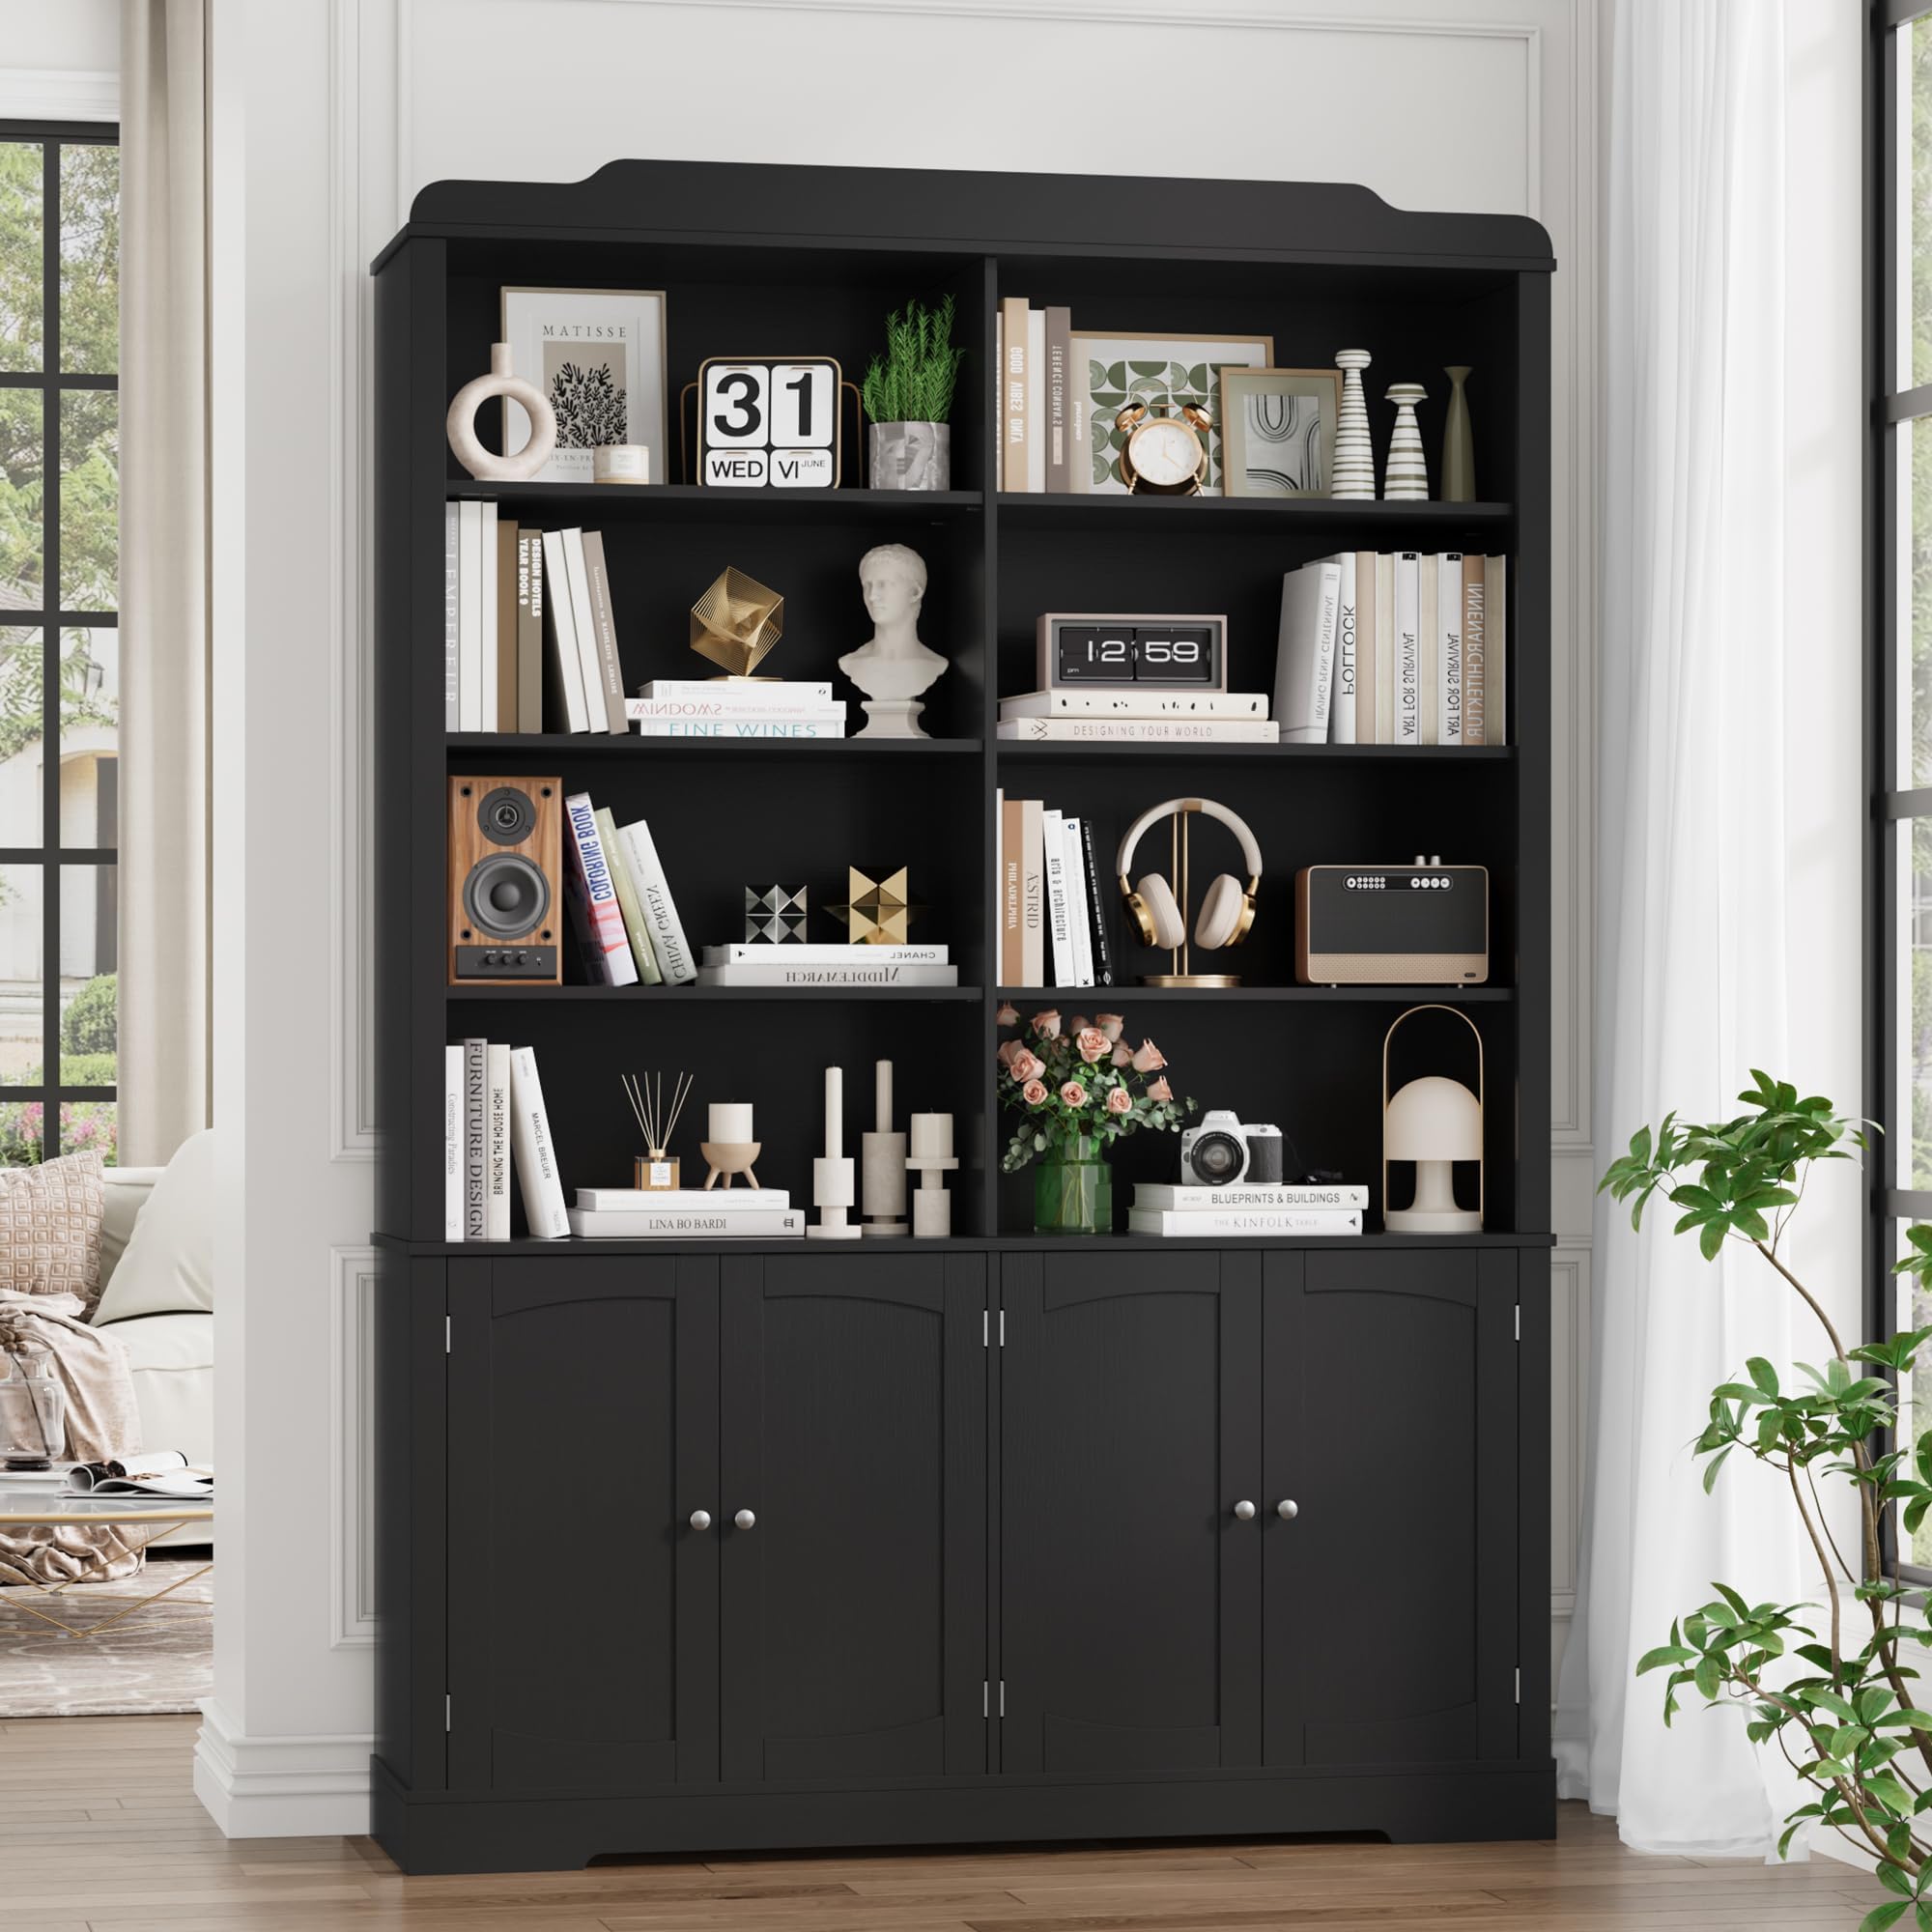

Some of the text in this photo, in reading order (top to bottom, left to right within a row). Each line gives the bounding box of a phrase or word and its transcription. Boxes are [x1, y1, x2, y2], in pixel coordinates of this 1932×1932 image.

[543, 325, 627, 338] MATISSE
[711, 461, 763, 478] WED
[778, 461, 799, 478] VI
[801, 459, 826, 468] JUNE
[519, 538, 528, 565] YEAR
[519, 567, 528, 596] BOOK
[531, 538, 542, 617] DESIGN HOTELS
[669, 723, 818, 738] FINE WINES
[1073, 725, 1212, 737] DESIGNING YOUR WORLD
[1008, 862, 1017, 929] PHILADELPHIA
[1027, 871, 1039, 929] ASTRID
[469, 1042, 483, 1237] FURNITURE DESIGN
[493, 1088, 503, 1196] BRINGING THE HOUSE HOME
[531, 1112, 552, 1180] MARCEL BREUER
[1211, 1193, 1274, 1205] BLUEPRINTS
[1276, 1193, 1284, 1205] &
[1286, 1192, 1341, 1204] BUILDINGS
[649, 1218, 726, 1230] LINA BO BARDI
[1233, 1217, 1293, 1229] KINFOLK
